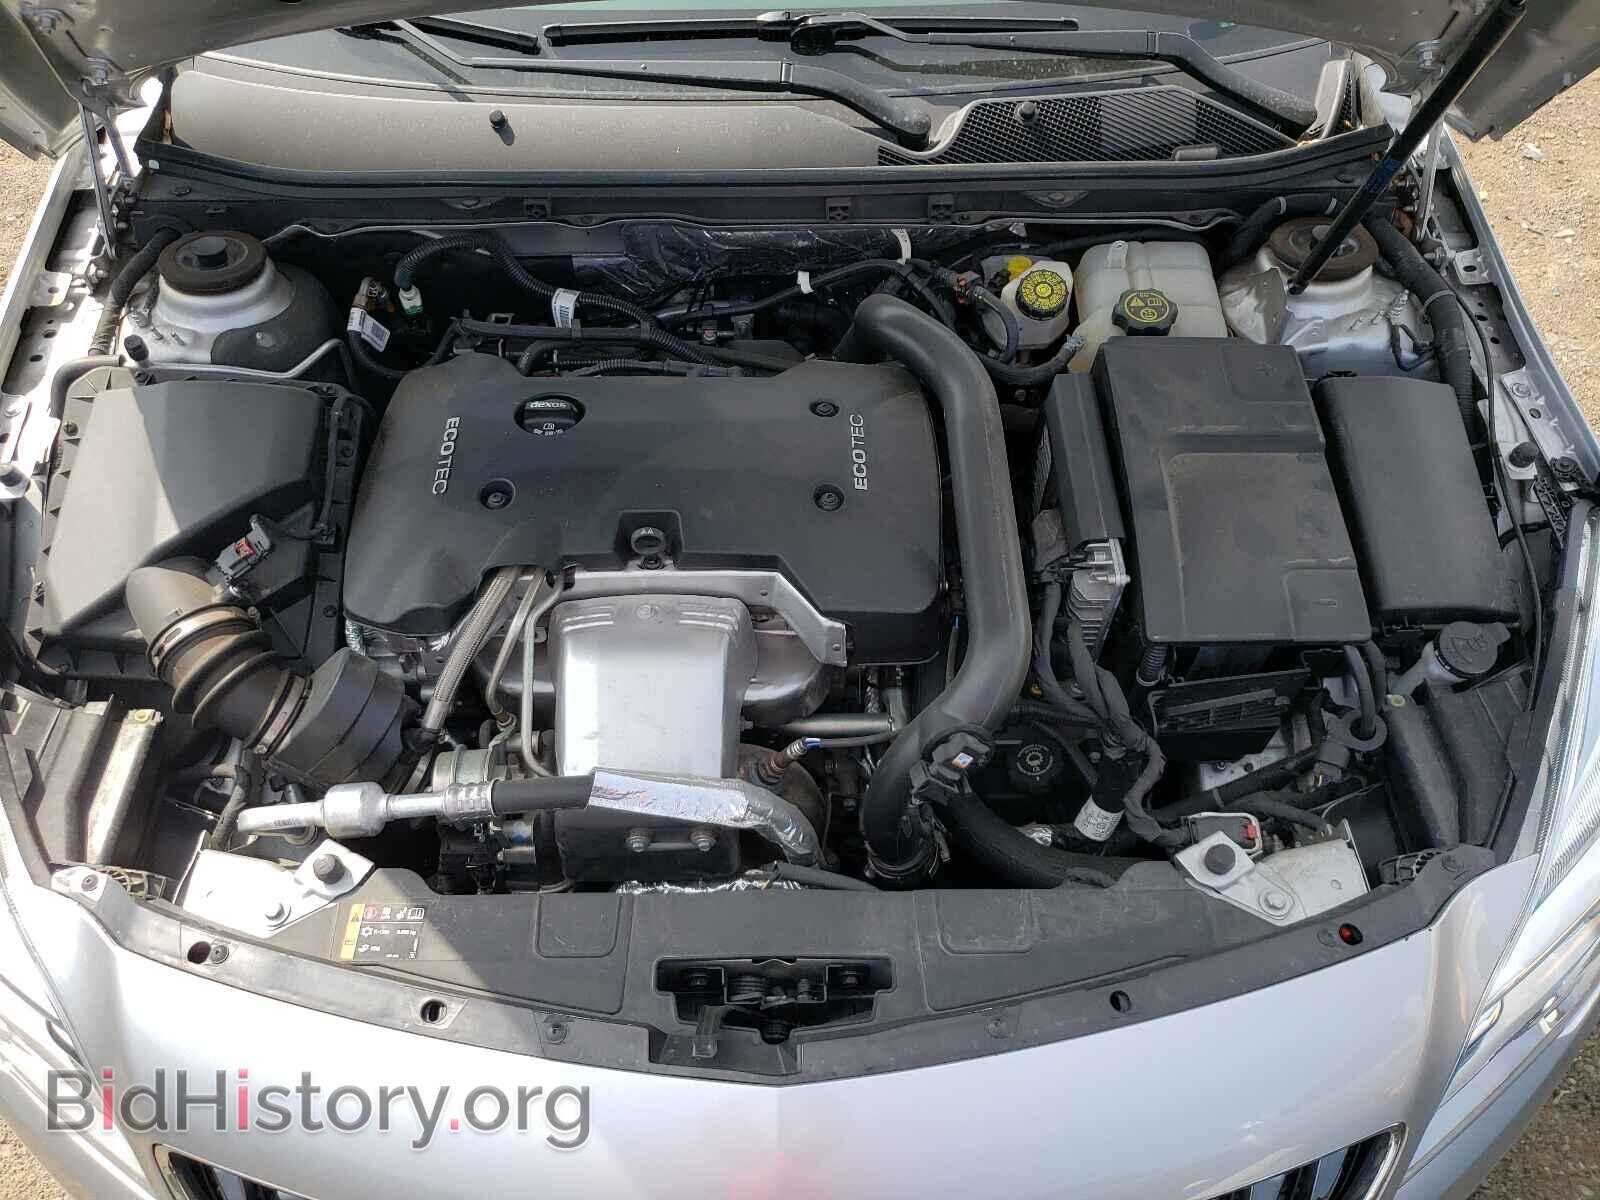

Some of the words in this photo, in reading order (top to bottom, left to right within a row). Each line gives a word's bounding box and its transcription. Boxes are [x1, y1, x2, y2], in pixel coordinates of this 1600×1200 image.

[529, 400, 568, 408] dexos
[432, 417, 460, 495] ECOTEC
[850, 414, 868, 490] ECOTEC
